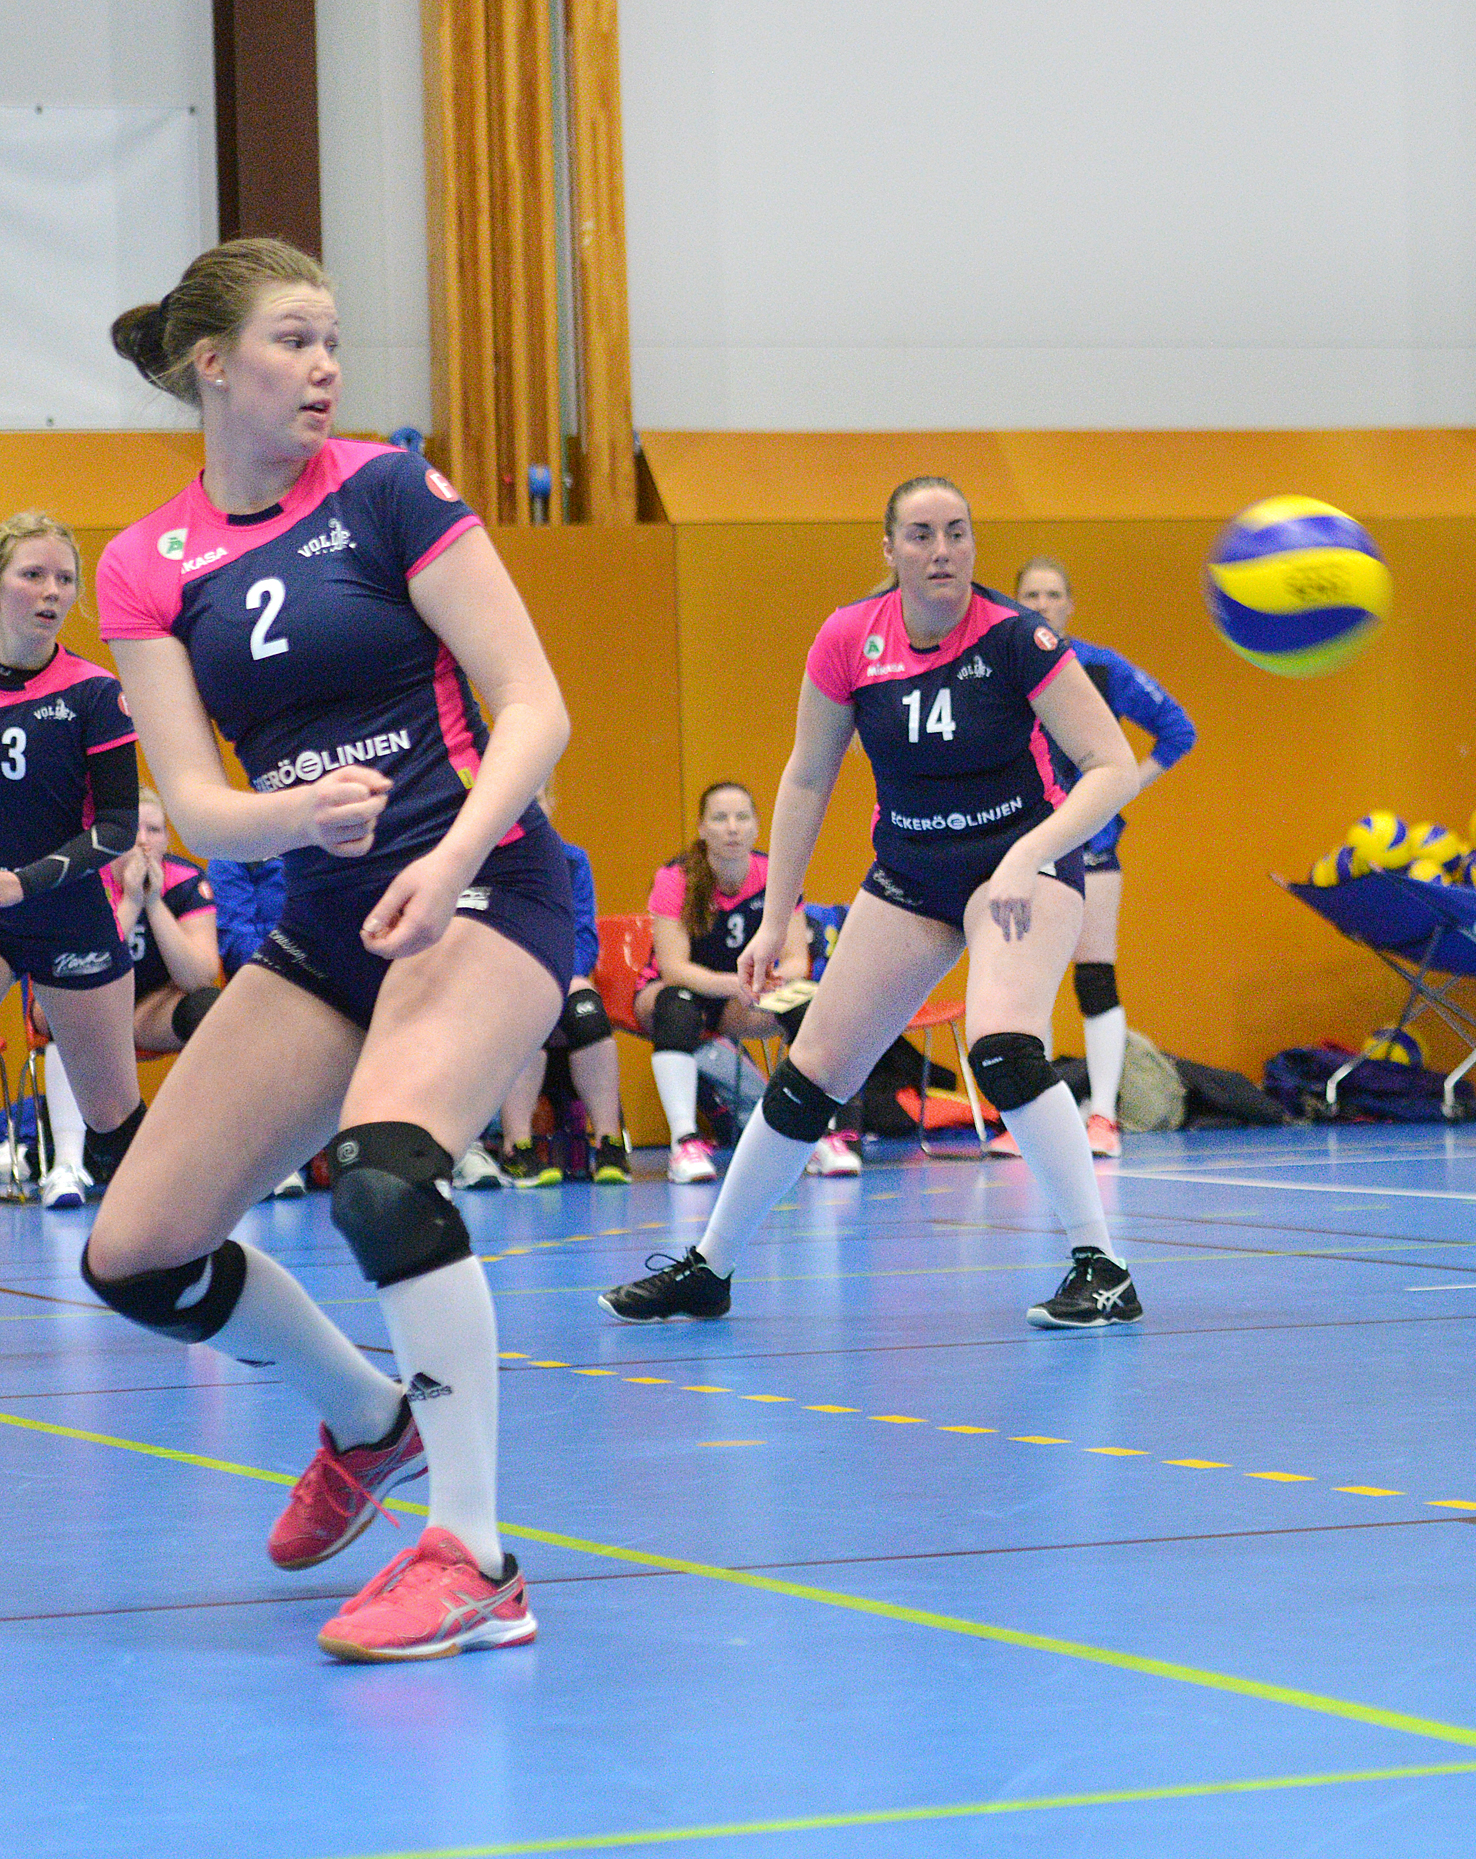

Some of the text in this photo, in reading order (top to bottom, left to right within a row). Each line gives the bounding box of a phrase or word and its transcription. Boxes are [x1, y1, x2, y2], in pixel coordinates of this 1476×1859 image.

[180, 547, 228, 574] KASA
[246, 578, 290, 661] 2
[902, 687, 956, 743] 14
[321, 730, 411, 771] LINJEN
[891, 796, 1023, 831] ECKERÖ LINJEN
[725, 912, 745, 949] 3
